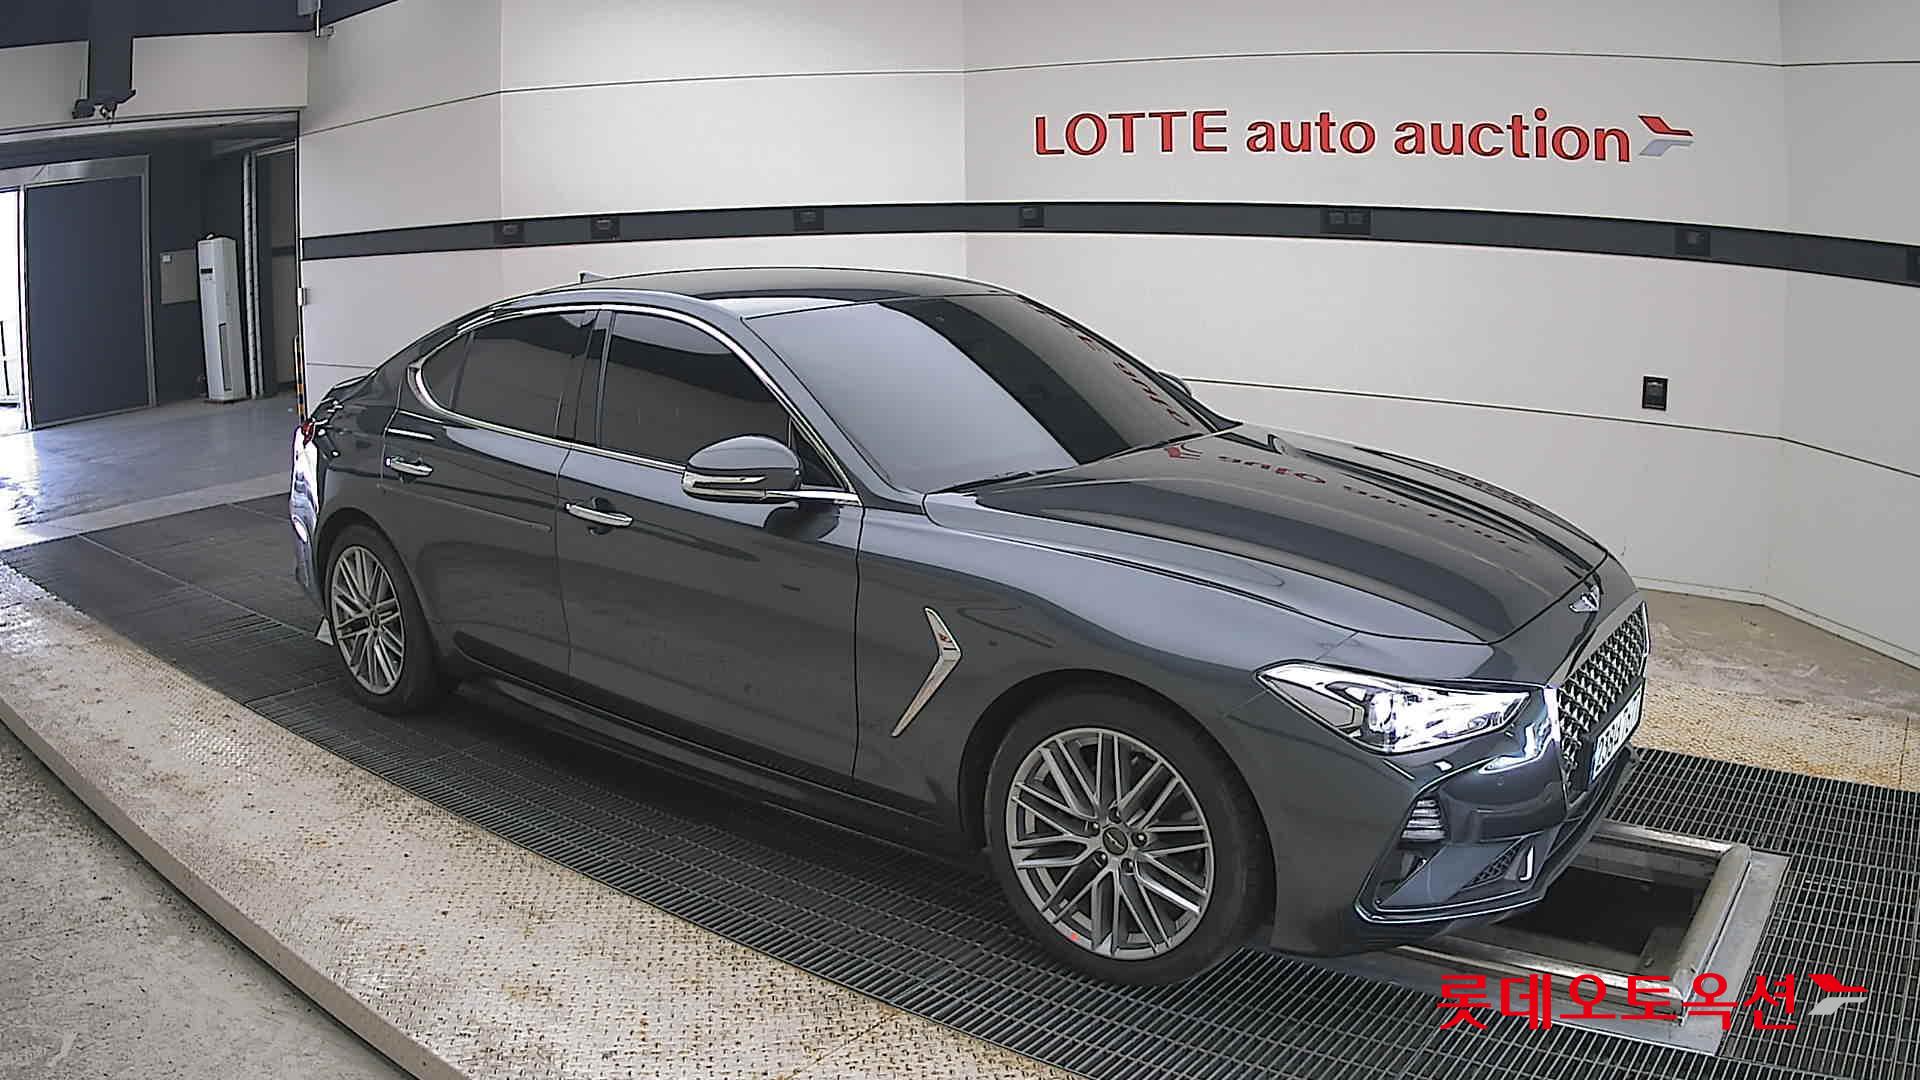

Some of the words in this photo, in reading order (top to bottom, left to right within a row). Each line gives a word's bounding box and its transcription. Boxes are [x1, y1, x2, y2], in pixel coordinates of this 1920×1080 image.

[1034, 110, 1228, 155] LOTTE
[1246, 112, 1375, 154] auto
[1394, 108, 1630, 162] auction
